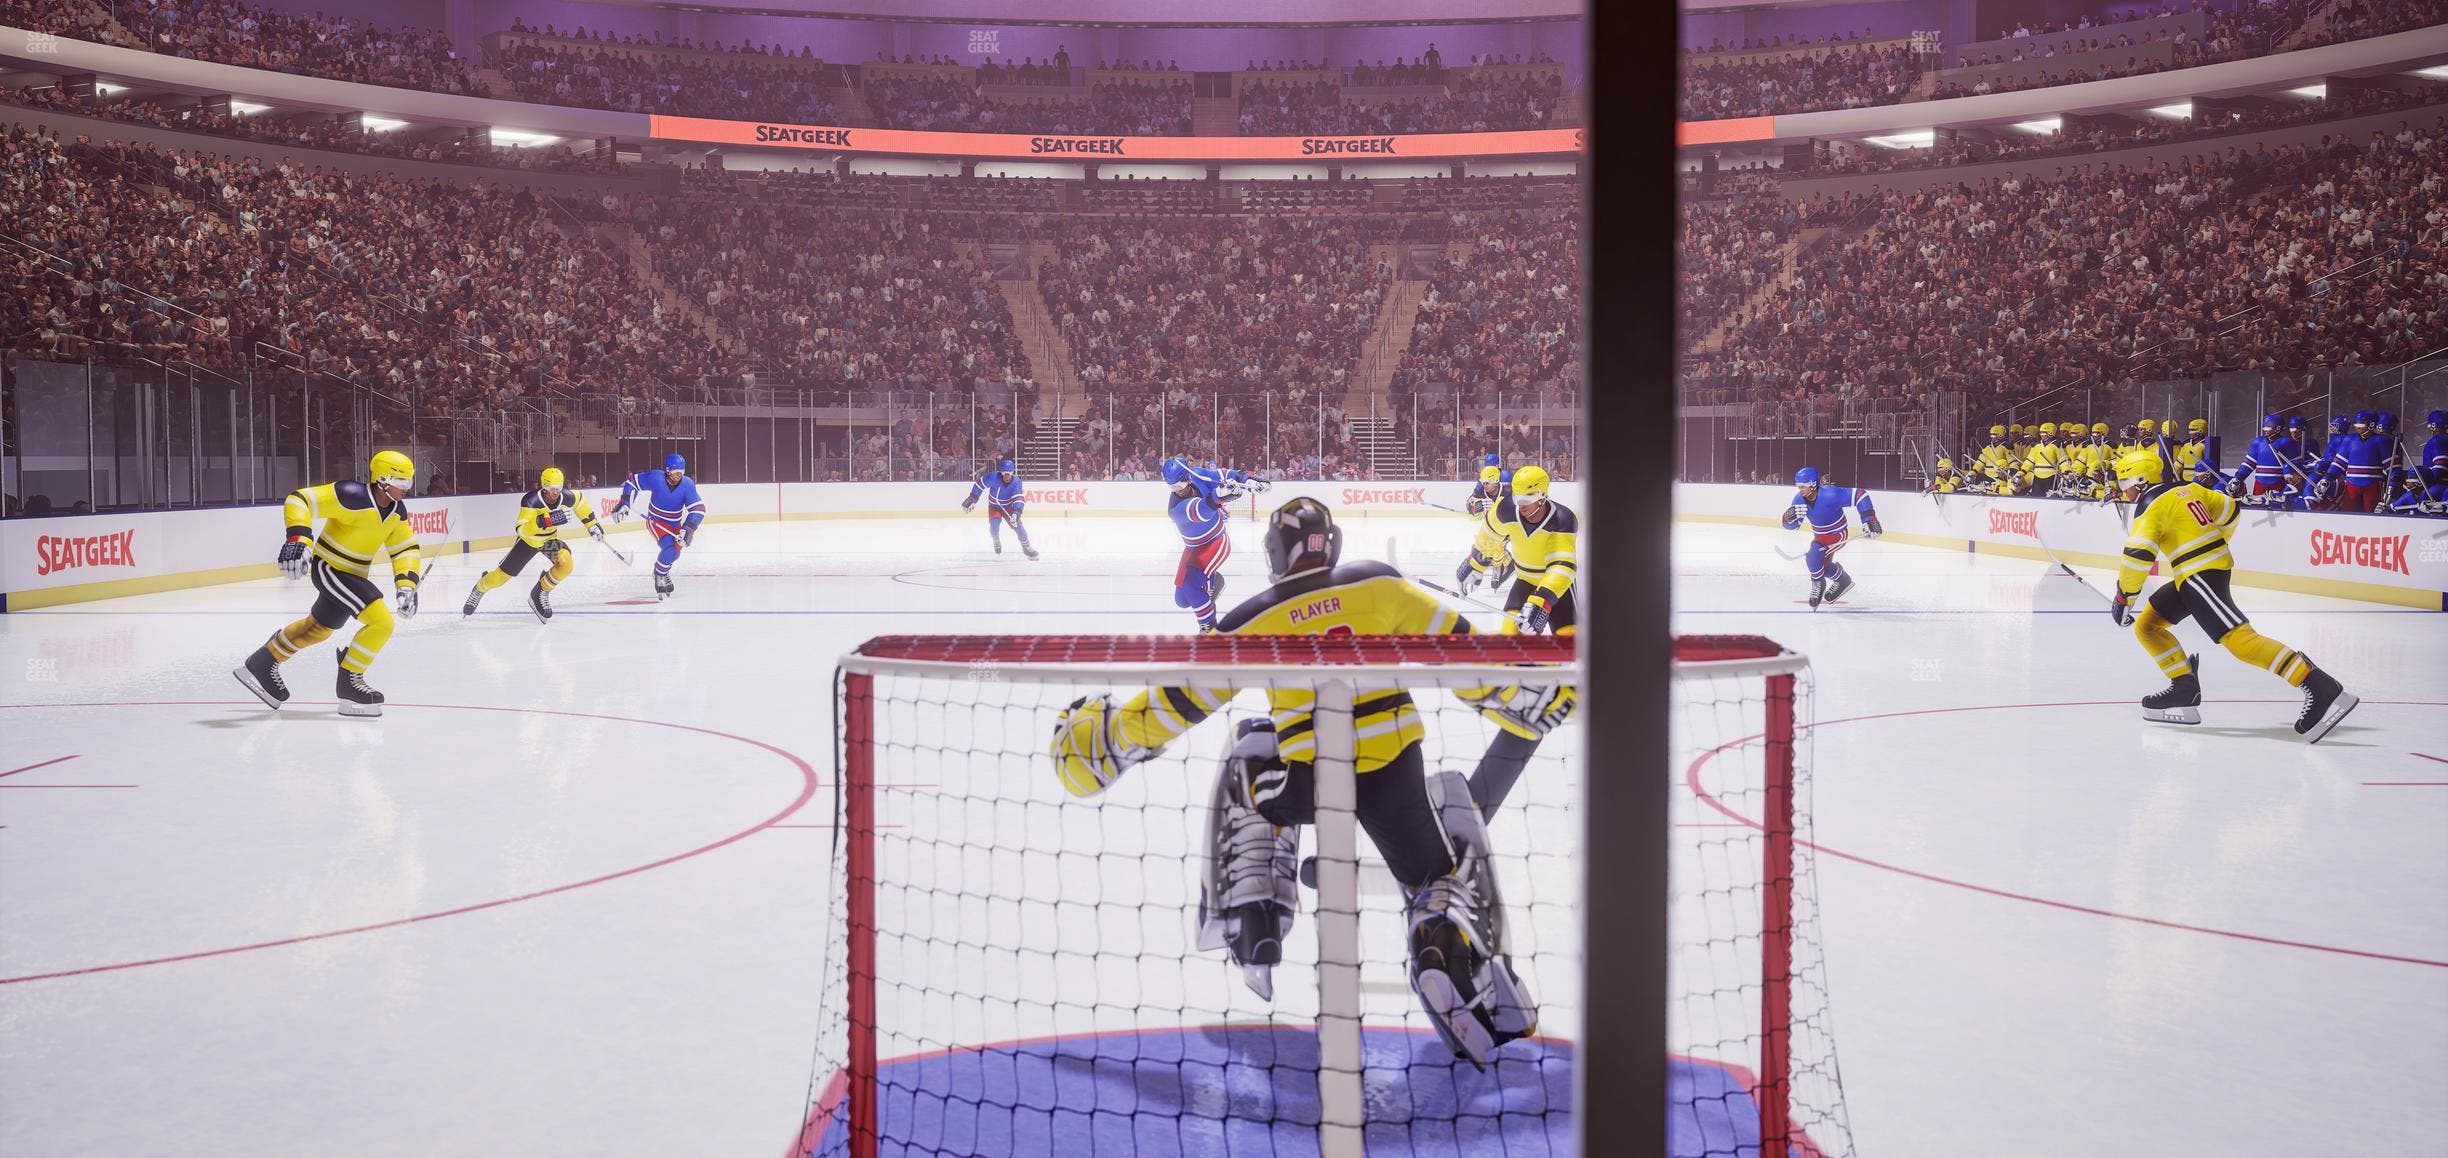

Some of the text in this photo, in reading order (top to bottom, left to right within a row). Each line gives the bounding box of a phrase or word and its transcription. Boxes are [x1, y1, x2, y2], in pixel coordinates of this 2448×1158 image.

[756, 125, 851, 147] SEATGEEK
[1031, 137, 1124, 155] SEATGEEK
[1302, 137, 1395, 155] SEATGEEK
[1024, 488, 1088, 505] ATGEEK
[1342, 488, 1425, 505] SEATGEEK
[407, 507, 449, 535] EATGEEK
[1989, 507, 2039, 539] SEATGEEK
[2187, 499, 2213, 527] 00
[37, 528, 136, 576] SEATGEEK
[1308, 533, 1325, 552] 00
[2310, 529, 2410, 577] SEATGEEK
[1289, 597, 1342, 625] PLAYER
